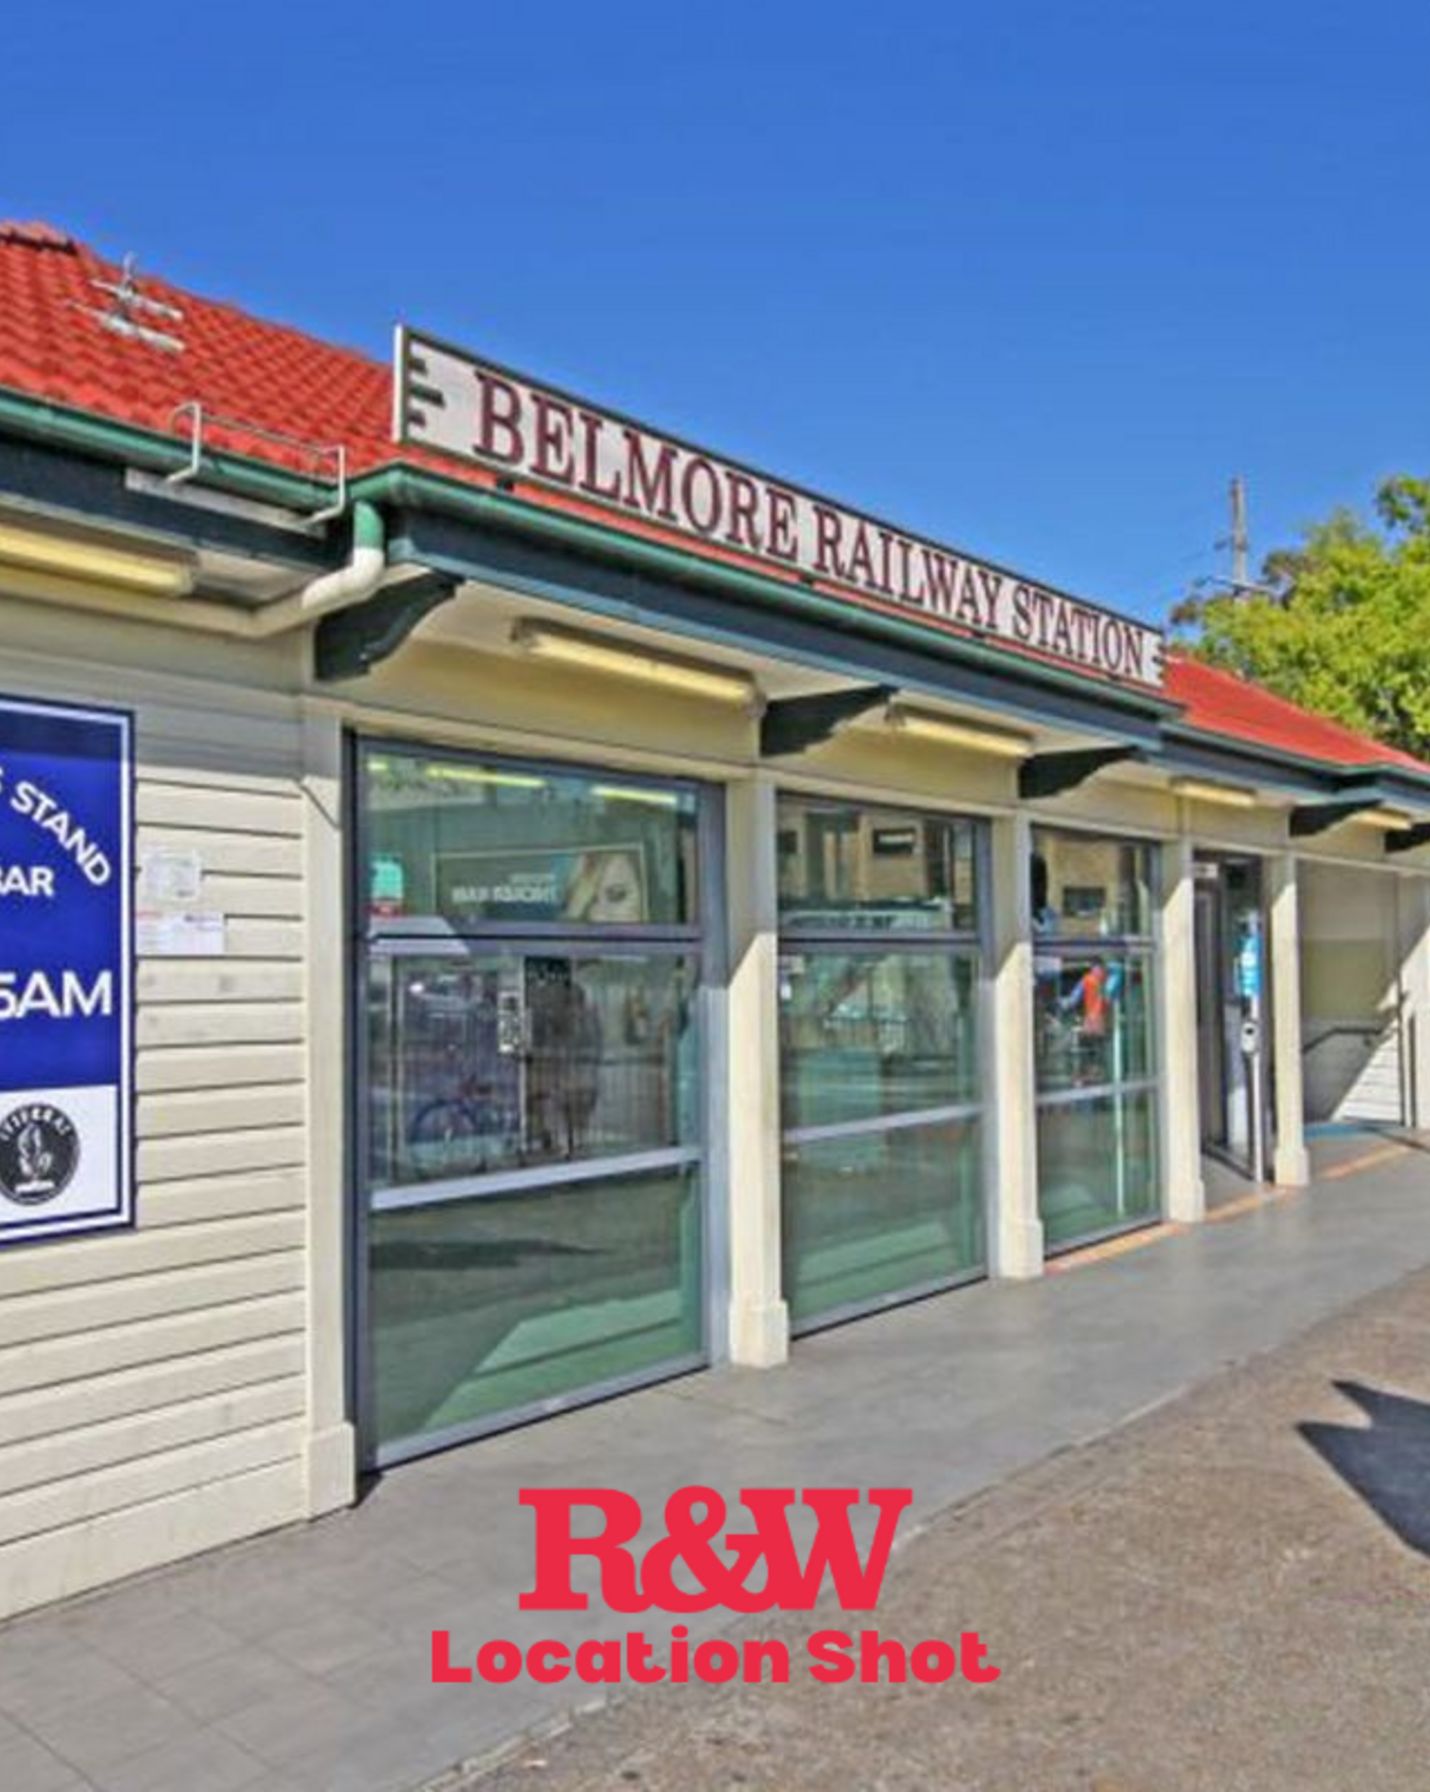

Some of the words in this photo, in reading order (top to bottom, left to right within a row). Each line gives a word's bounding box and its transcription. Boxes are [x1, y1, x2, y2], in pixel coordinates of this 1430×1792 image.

[473, 370, 798, 561] BELMORE
[813, 505, 1003, 629] RAILWAY
[1011, 585, 1144, 678] STATION
[0, 866, 54, 897] AR
[10, 780, 111, 885] STAND
